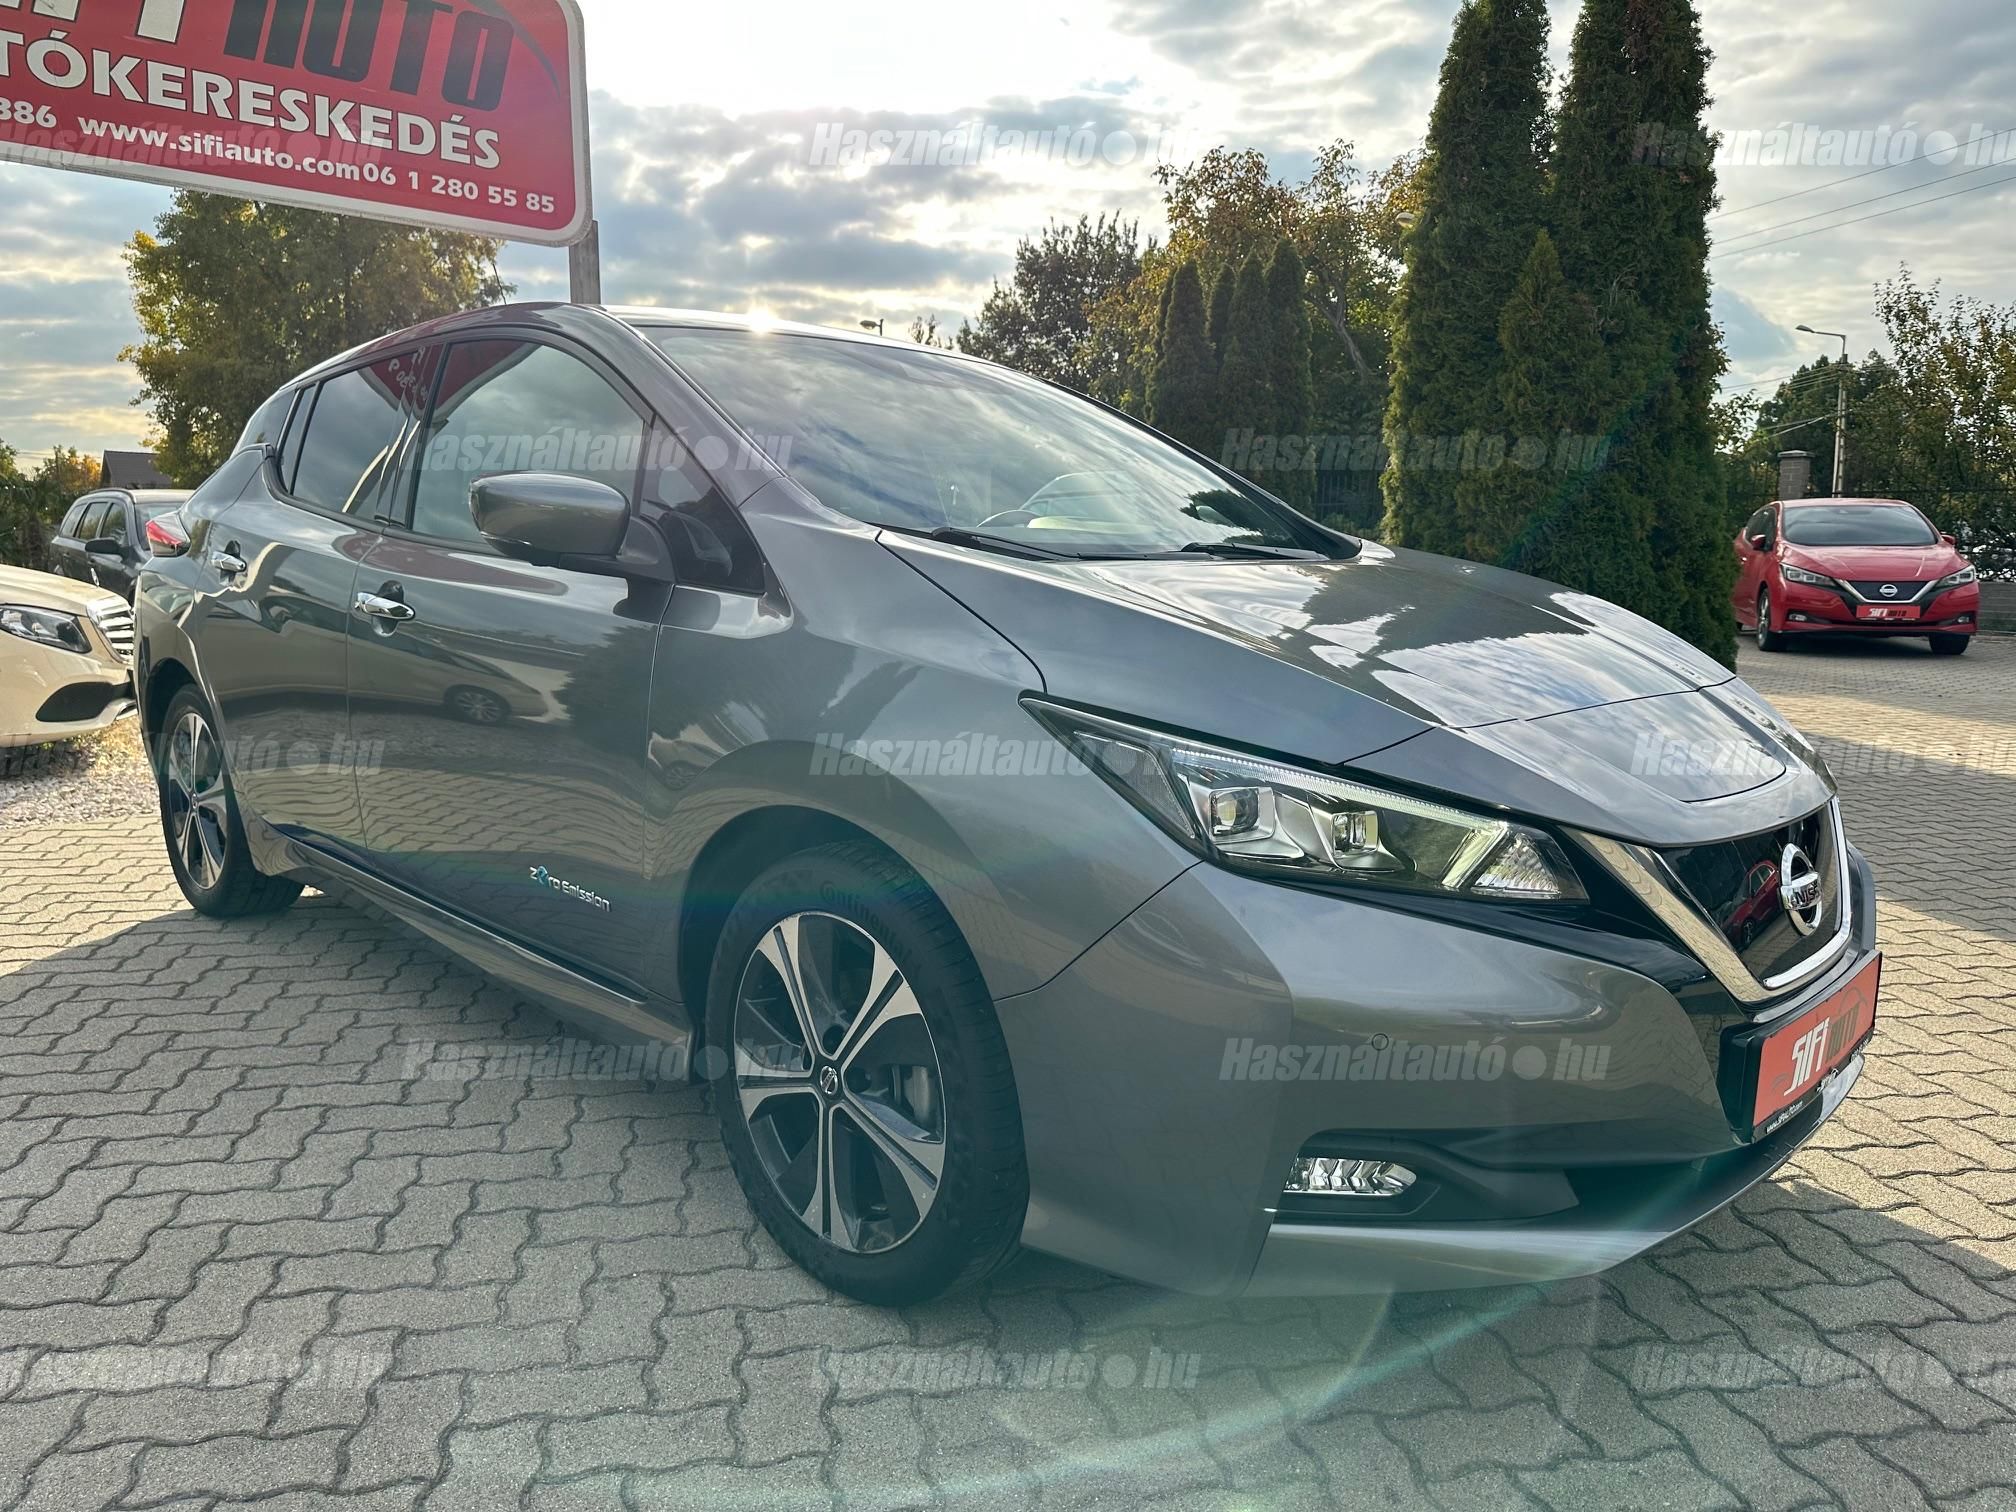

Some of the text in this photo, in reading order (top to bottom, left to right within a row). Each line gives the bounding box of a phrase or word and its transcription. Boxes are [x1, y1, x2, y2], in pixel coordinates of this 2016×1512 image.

[362, 162, 397, 185] 06
[408, 171, 419, 190] 1
[431, 175, 479, 200] 280
[488, 185, 518, 206] 55
[525, 193, 554, 213] 85
